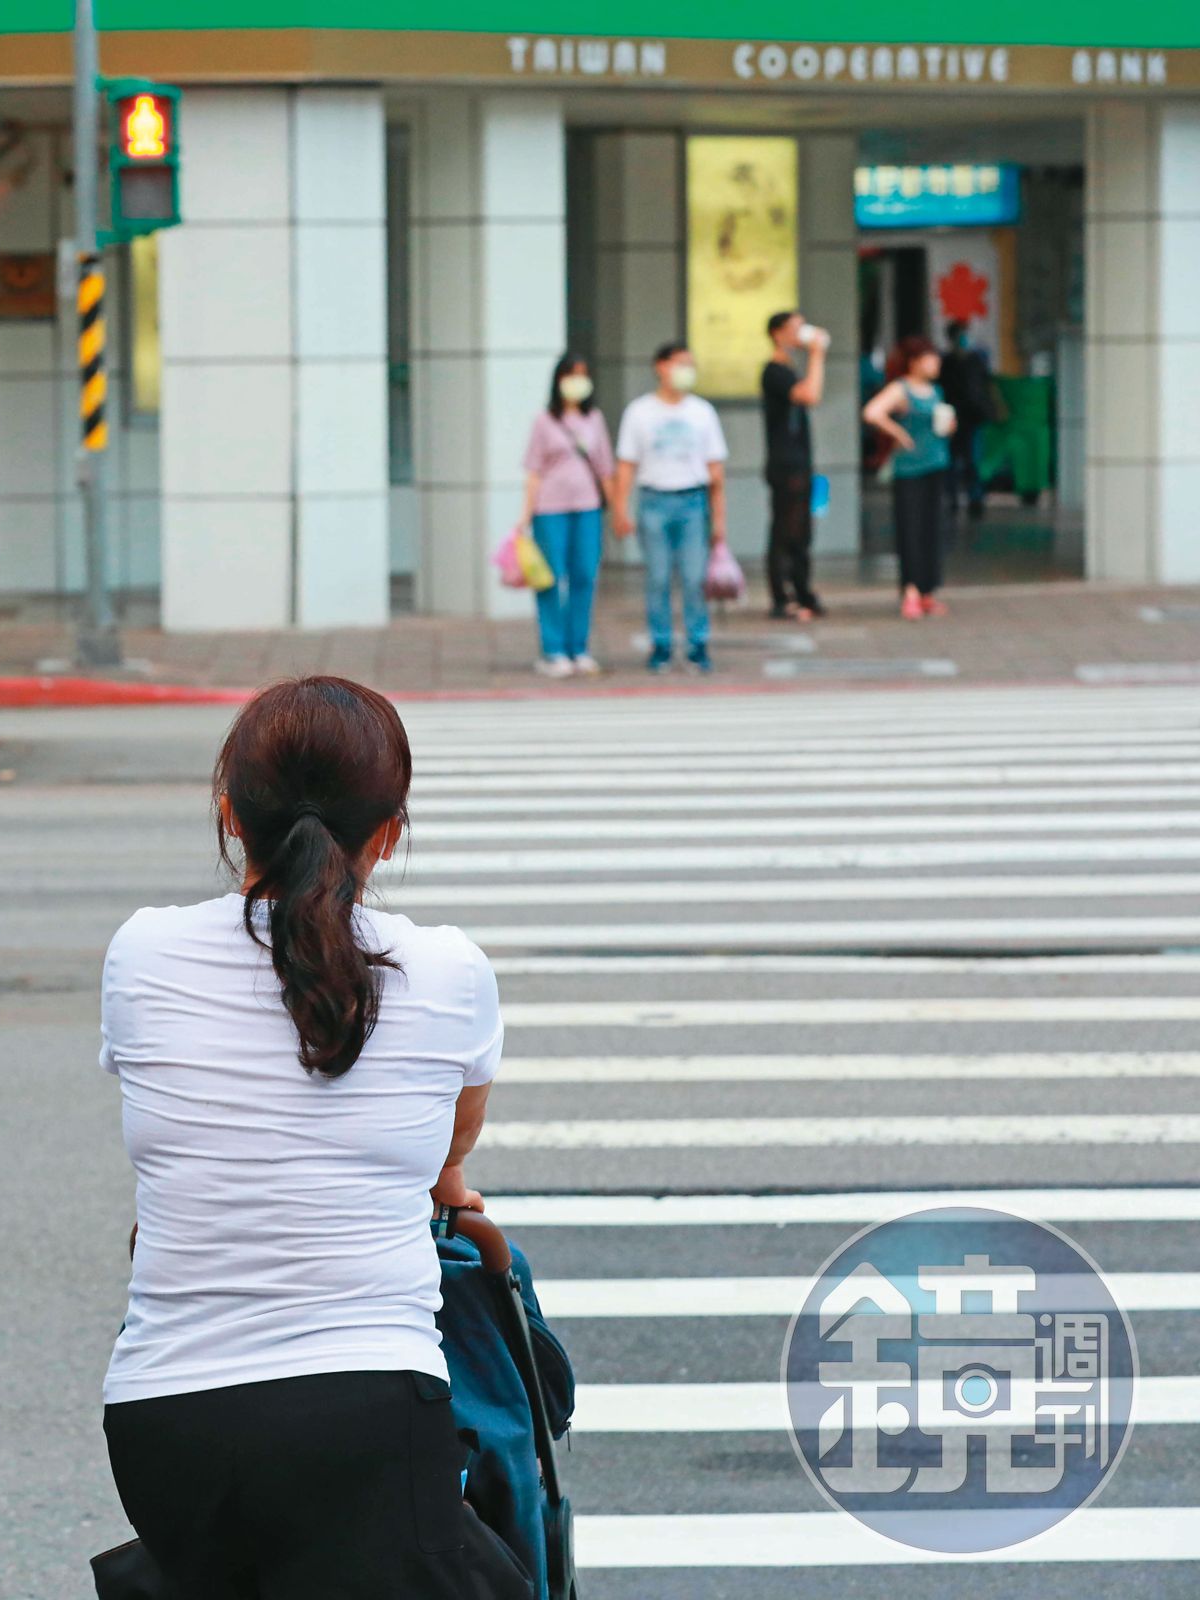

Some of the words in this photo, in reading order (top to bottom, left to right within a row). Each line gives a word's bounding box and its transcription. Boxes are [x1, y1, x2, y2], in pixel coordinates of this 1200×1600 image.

[506, 36, 666, 75] TAIWAN
[732, 43, 1009, 82] COOPERATIVE
[1070, 48, 1167, 85] BANK
